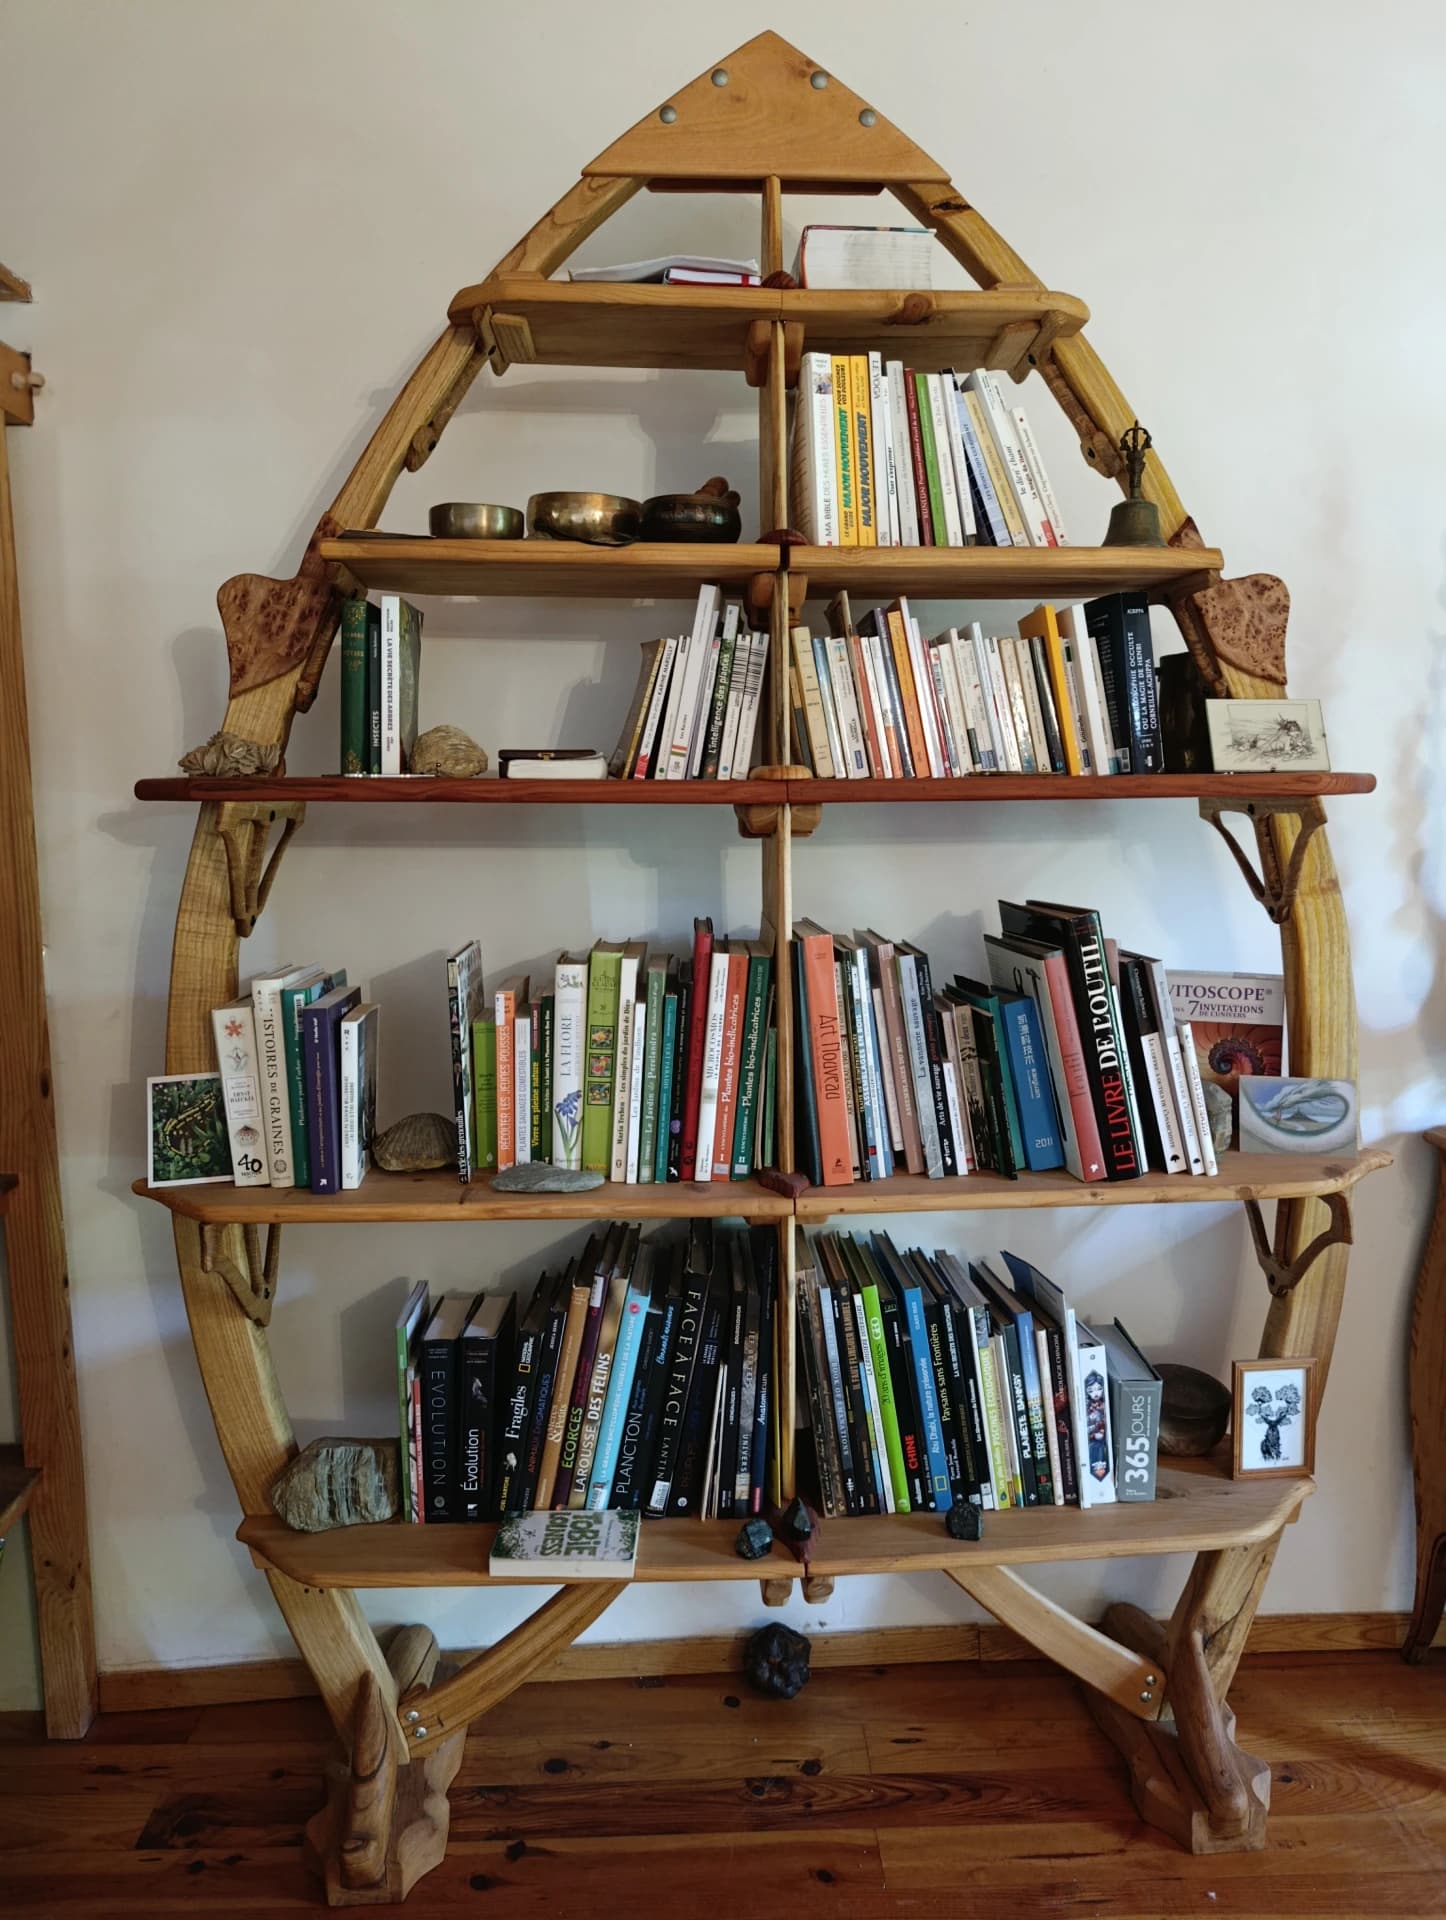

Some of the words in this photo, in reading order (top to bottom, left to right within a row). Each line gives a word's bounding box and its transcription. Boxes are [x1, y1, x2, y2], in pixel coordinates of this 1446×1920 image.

[872, 360, 879, 368] LE
[839, 407, 850, 472] MOUVEMENT
[857, 412, 870, 486] MOUVEMENT
[887, 446, 896, 478] s'exprimer
[841, 473, 852, 508] MAJOR
[860, 486, 872, 527] MAJOR
[387, 638, 393, 646] LA
[657, 674, 667, 695] KARINE
[662, 645, 674, 673] MARSILLY
[719, 653, 730, 684] plantes
[1137, 669, 1144, 678] DE
[716, 686, 726, 699] des
[1139, 681, 1147, 703] MAGIE
[1141, 706, 1147, 714] LA
[1142, 718, 1149, 729] OU
[372, 710, 380, 747] INSECTES
[708, 701, 723, 753] L'intelligence
[1077, 714, 1087, 742] Gounelle
[1080, 935, 1111, 1030] L'OUTIL
[623, 999, 632, 1014] Dieu
[909, 998, 920, 1029] sauvage
[1188, 1000, 1199, 1016] 7
[1199, 1003, 1264, 1014] INVITATIONS
[558, 1014, 572, 1056] FLORE
[621, 1022, 630, 1046] jardin
[726, 993, 740, 1066] bio-indicatrices
[746, 996, 762, 1069] bio-indicatrices
[819, 1015, 837, 1038] Art
[856, 1014, 864, 1033] BOIS
[262, 1008, 278, 1078] ISTOIRES
[499, 1026, 510, 1062] POUSSES
[706, 1012, 718, 1079] MICROCOSMOS
[858, 1035, 865, 1047] EN
[895, 1036, 906, 1052] BOIS
[913, 1031, 925, 1063] vannerie
[1096, 1035, 1119, 1069] DE
[560, 1060, 572, 1076] LA
[620, 1054, 630, 1079] simples
[647, 1031, 658, 1079] Perelandra
[899, 1054, 907, 1064] DU
[499, 1065, 511, 1094] JEUNES
[518, 1050, 526, 1092] COMESTIBLES
[532, 1061, 540, 1086] nature
[821, 1042, 841, 1101] Nouveau
[844, 1066, 853, 1100] NOUVEAU
[860, 1048, 872, 1106] ASSEMBLAGES
[917, 1066, 927, 1078] La
[931, 1063, 942, 1089] sauvage
[270, 1082, 277, 1094] DE
[721, 1068, 734, 1103] Plantes
[741, 1071, 755, 1106] Plantes
[901, 1066, 913, 1116] ASSEMBLAGES
[499, 1097, 511, 1110] LES
[518, 1093, 526, 1124] SAUVAGES
[532, 1088, 541, 1112] pleine
[617, 1102, 626, 1123] Treben
[645, 1093, 655, 1120] Jardin
[937, 1102, 944, 1110] de
[1101, 1072, 1130, 1138] LIVRE
[269, 1097, 284, 1156] GRAINES
[455, 1110, 466, 1144] grenouilles
[499, 1112, 511, 1150] RÉCOLTER
[532, 1114, 540, 1124] en
[645, 1122, 653, 1133] Le
[937, 1111, 947, 1126] Arts
[519, 1126, 527, 1152] PLANTES
[532, 1126, 540, 1146] Vivre
[616, 1125, 624, 1144] Maria
[238, 1154, 262, 1173] 40
[457, 1145, 466, 1155] des
[458, 1156, 466, 1165] vie
[1114, 1140, 1136, 1170] LE
[458, 1166, 466, 1175] la
[677, 1290, 701, 1345] FACE
[841, 1301, 853, 1332] RAMIREZ
[870, 1317, 882, 1340] GEO
[520, 1340, 528, 1363] NATIONAL
[620, 1351, 628, 1360] DE
[622, 1342, 630, 1350] LA
[845, 1332, 858, 1364] FLINGUER
[929, 1323, 944, 1366] Frontières
[673, 1352, 691, 1365] À
[866, 1368, 873, 1376] LA
[875, 1344, 888, 1378] d'images
[590, 1352, 611, 1393] FÉLINS
[831, 1362, 839, 1384] BOOK
[850, 1365, 860, 1384] FAUT
[881, 1379, 889, 1392] ans
[919, 1357, 932, 1389] préservée
[935, 1367, 946, 1387] sans
[663, 1372, 686, 1428] FACE
[756, 1372, 768, 1425] Anatomicum
[835, 1387, 841, 1398] OF
[882, 1394, 890, 1404] 20
[923, 1390, 935, 1412] nature
[939, 1388, 952, 1421] Paysans
[504, 1385, 528, 1439] Fragiles
[556, 1403, 567, 1429] Petits
[586, 1397, 601, 1420] DES
[1130, 1395, 1145, 1437] JOURS
[431, 1370, 446, 1485] EVOLUTION
[547, 1429, 562, 1443] &
[561, 1407, 582, 1468] ÉCORCES
[836, 1400, 849, 1456] EMANATIONS
[927, 1420, 939, 1440] Dhabi,
[460, 1428, 479, 1490] Évolution
[574, 1425, 597, 1493] LAROUSSE
[602, 1442, 613, 1468] GRANDE
[615, 1411, 643, 1494] PLANCTON
[905, 1434, 919, 1470] CHINE
[930, 1441, 940, 1453] Abu
[1034, 1431, 1047, 1460] TERRE
[600, 1469, 607, 1478] LA
[1124, 1437, 1149, 1483] 365
